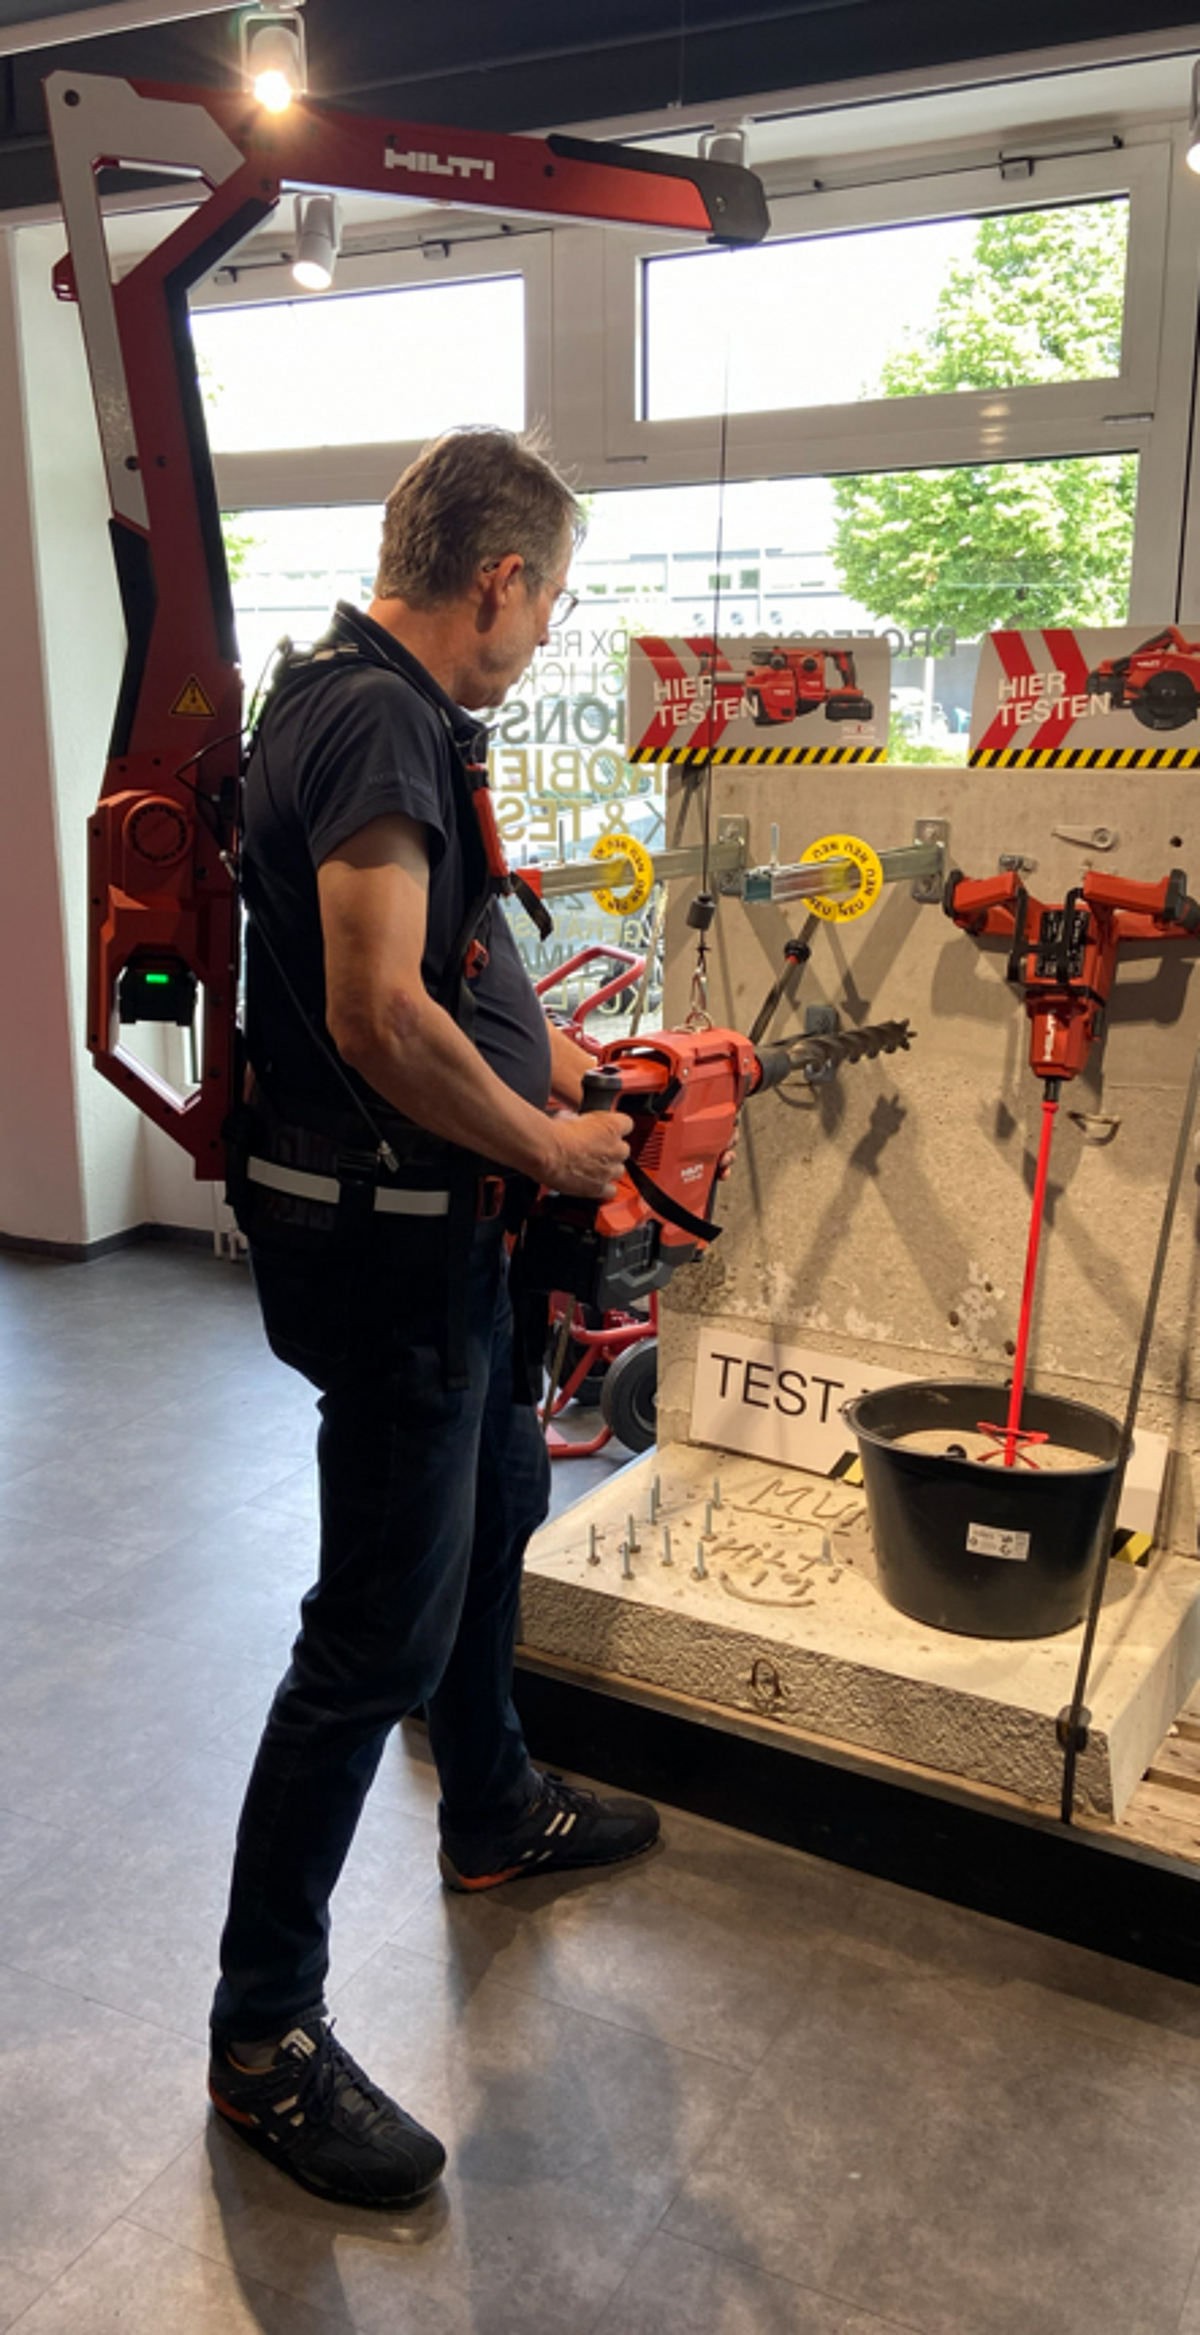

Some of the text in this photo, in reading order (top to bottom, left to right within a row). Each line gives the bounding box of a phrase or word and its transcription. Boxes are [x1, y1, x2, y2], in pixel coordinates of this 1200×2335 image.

[384, 148, 495, 181] HILTI
[998, 671, 1067, 700] HIER
[654, 695, 760, 728] TESTEN
[996, 692, 1112, 727] TESTEN
[811, 842, 840, 859] NEU
[843, 841, 869, 865] NEU
[862, 867, 876, 897] NEU
[838, 898, 866, 916] NEU
[710, 1353, 844, 1424] TEST
